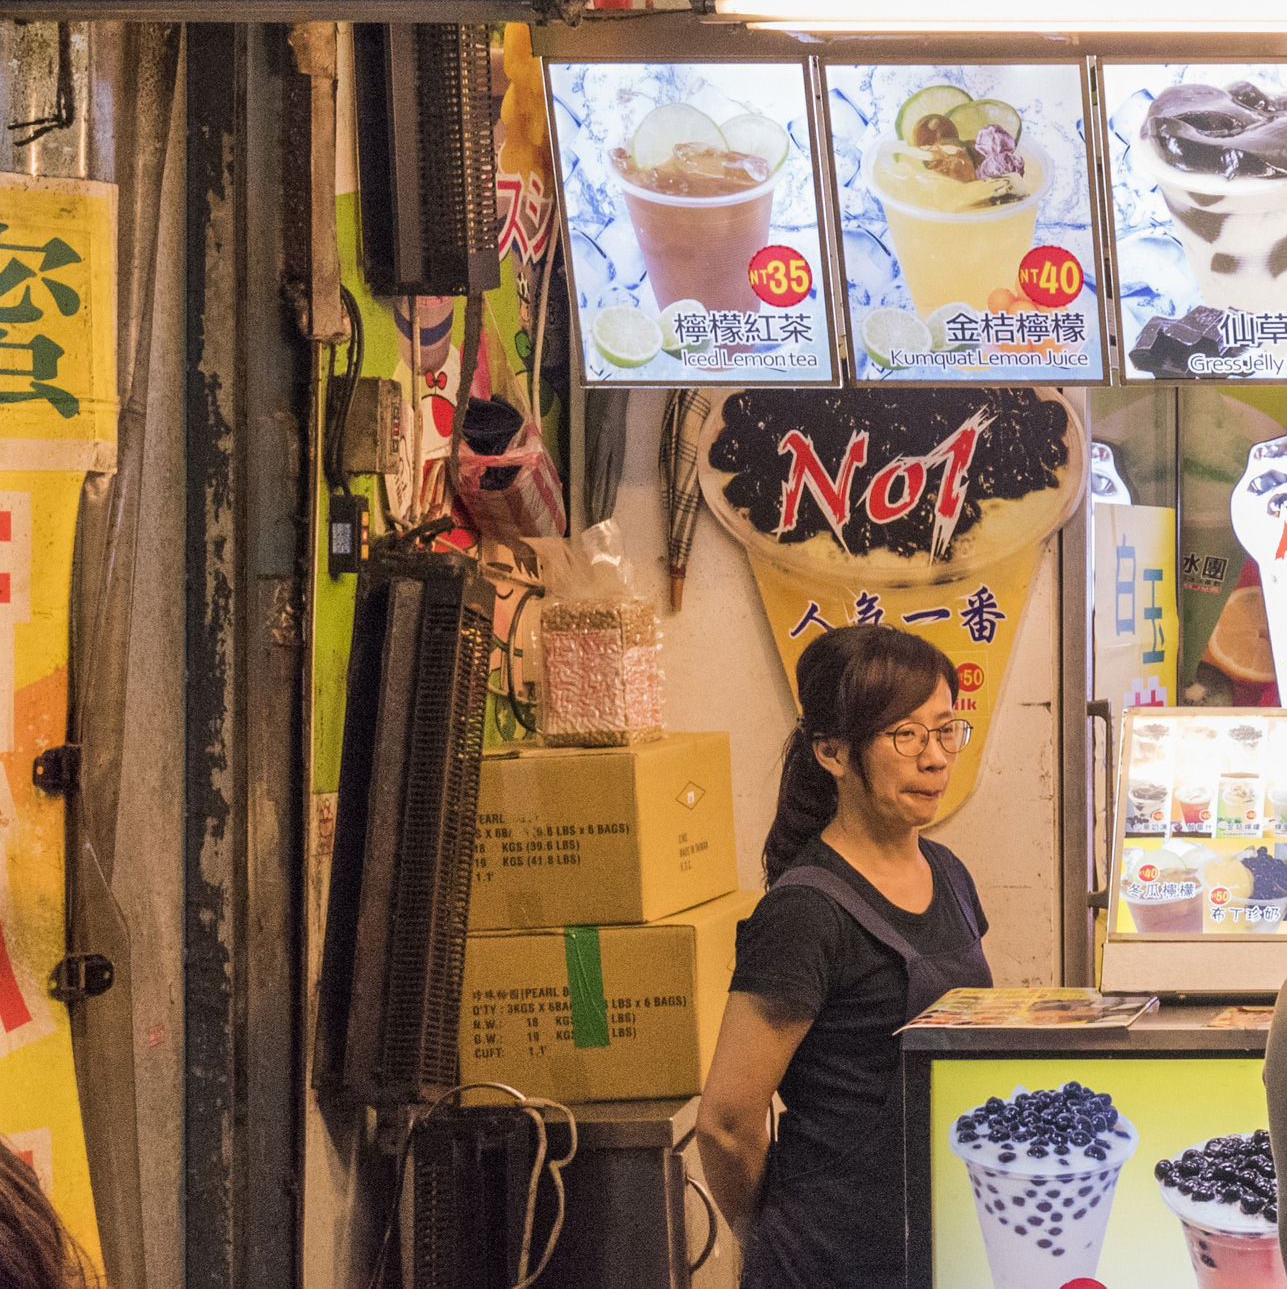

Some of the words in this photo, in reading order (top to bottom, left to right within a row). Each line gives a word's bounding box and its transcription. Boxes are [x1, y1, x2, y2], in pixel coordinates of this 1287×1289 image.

[674, 313, 813, 344] 檸檬紅茶
[945, 313, 1085, 344] 金桔檸檬
[683, 350, 718, 366] Iced
[721, 350, 787, 366] Lemon
[789, 352, 818, 367] tea
[891, 350, 974, 370] Kumquat
[977, 350, 1042, 366] Lemon
[1045, 350, 1088, 367] Juice
[778, 416, 985, 546] No1
